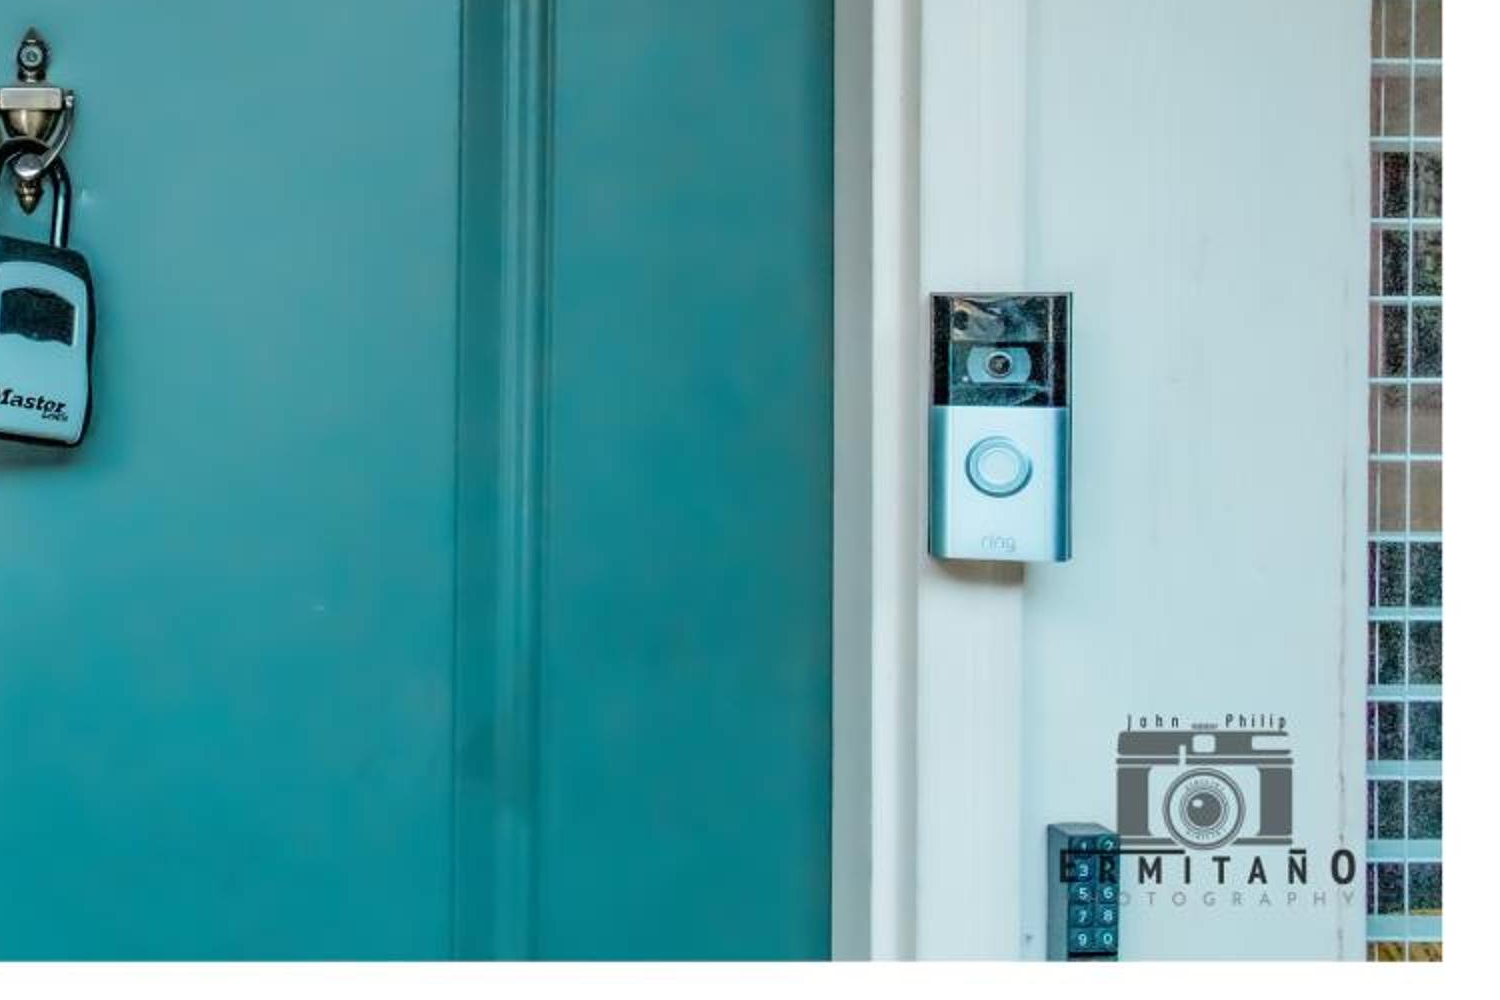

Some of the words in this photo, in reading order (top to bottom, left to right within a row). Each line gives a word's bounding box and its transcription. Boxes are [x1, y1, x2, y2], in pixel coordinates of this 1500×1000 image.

[980, 535, 1017, 554] ring
[1079, 864, 1089, 877] 3
[1079, 886, 1089, 899] 5
[1102, 885, 1114, 899] 6
[1078, 910, 1088, 923] 7
[1102, 909, 1114, 922] 8
[1077, 932, 1088, 947] 9
[1102, 932, 1113, 945] 0
